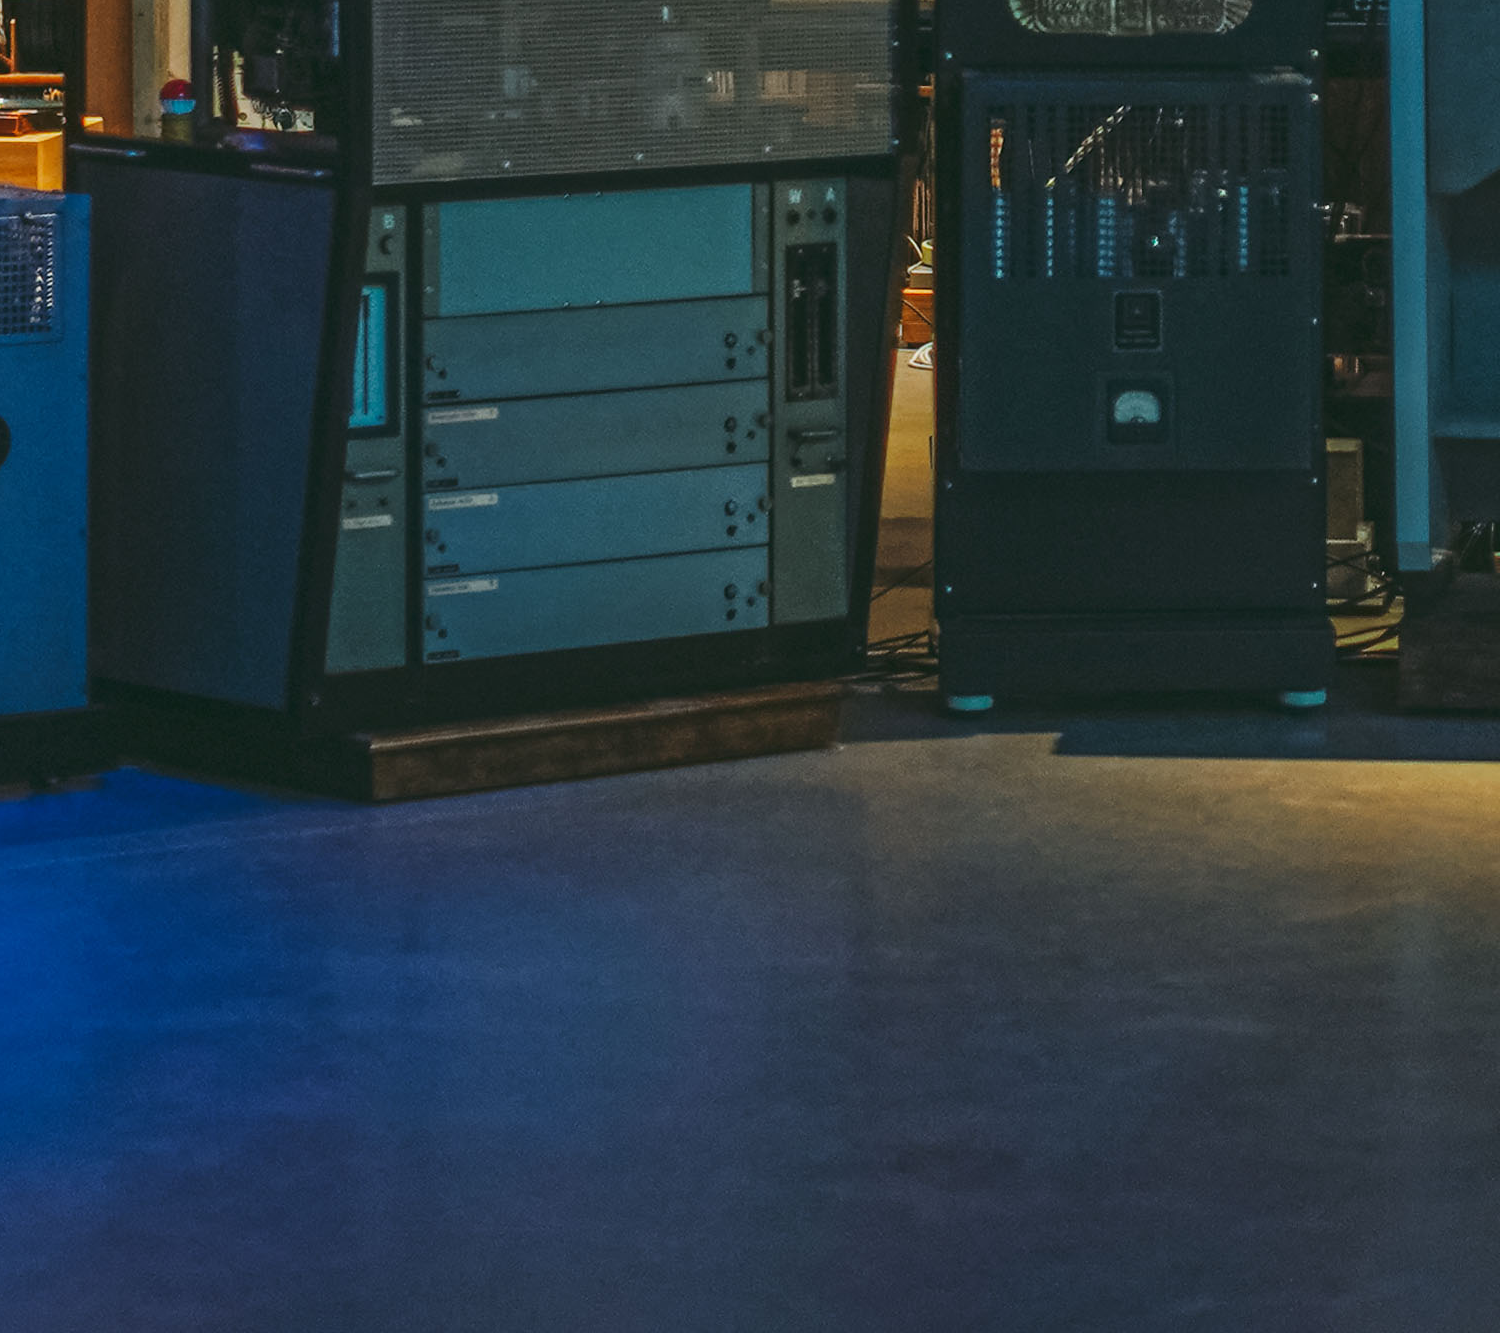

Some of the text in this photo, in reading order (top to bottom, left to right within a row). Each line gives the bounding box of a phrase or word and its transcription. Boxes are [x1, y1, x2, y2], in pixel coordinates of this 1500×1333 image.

[788, 186, 835, 203] W A
[382, 213, 395, 229] B
